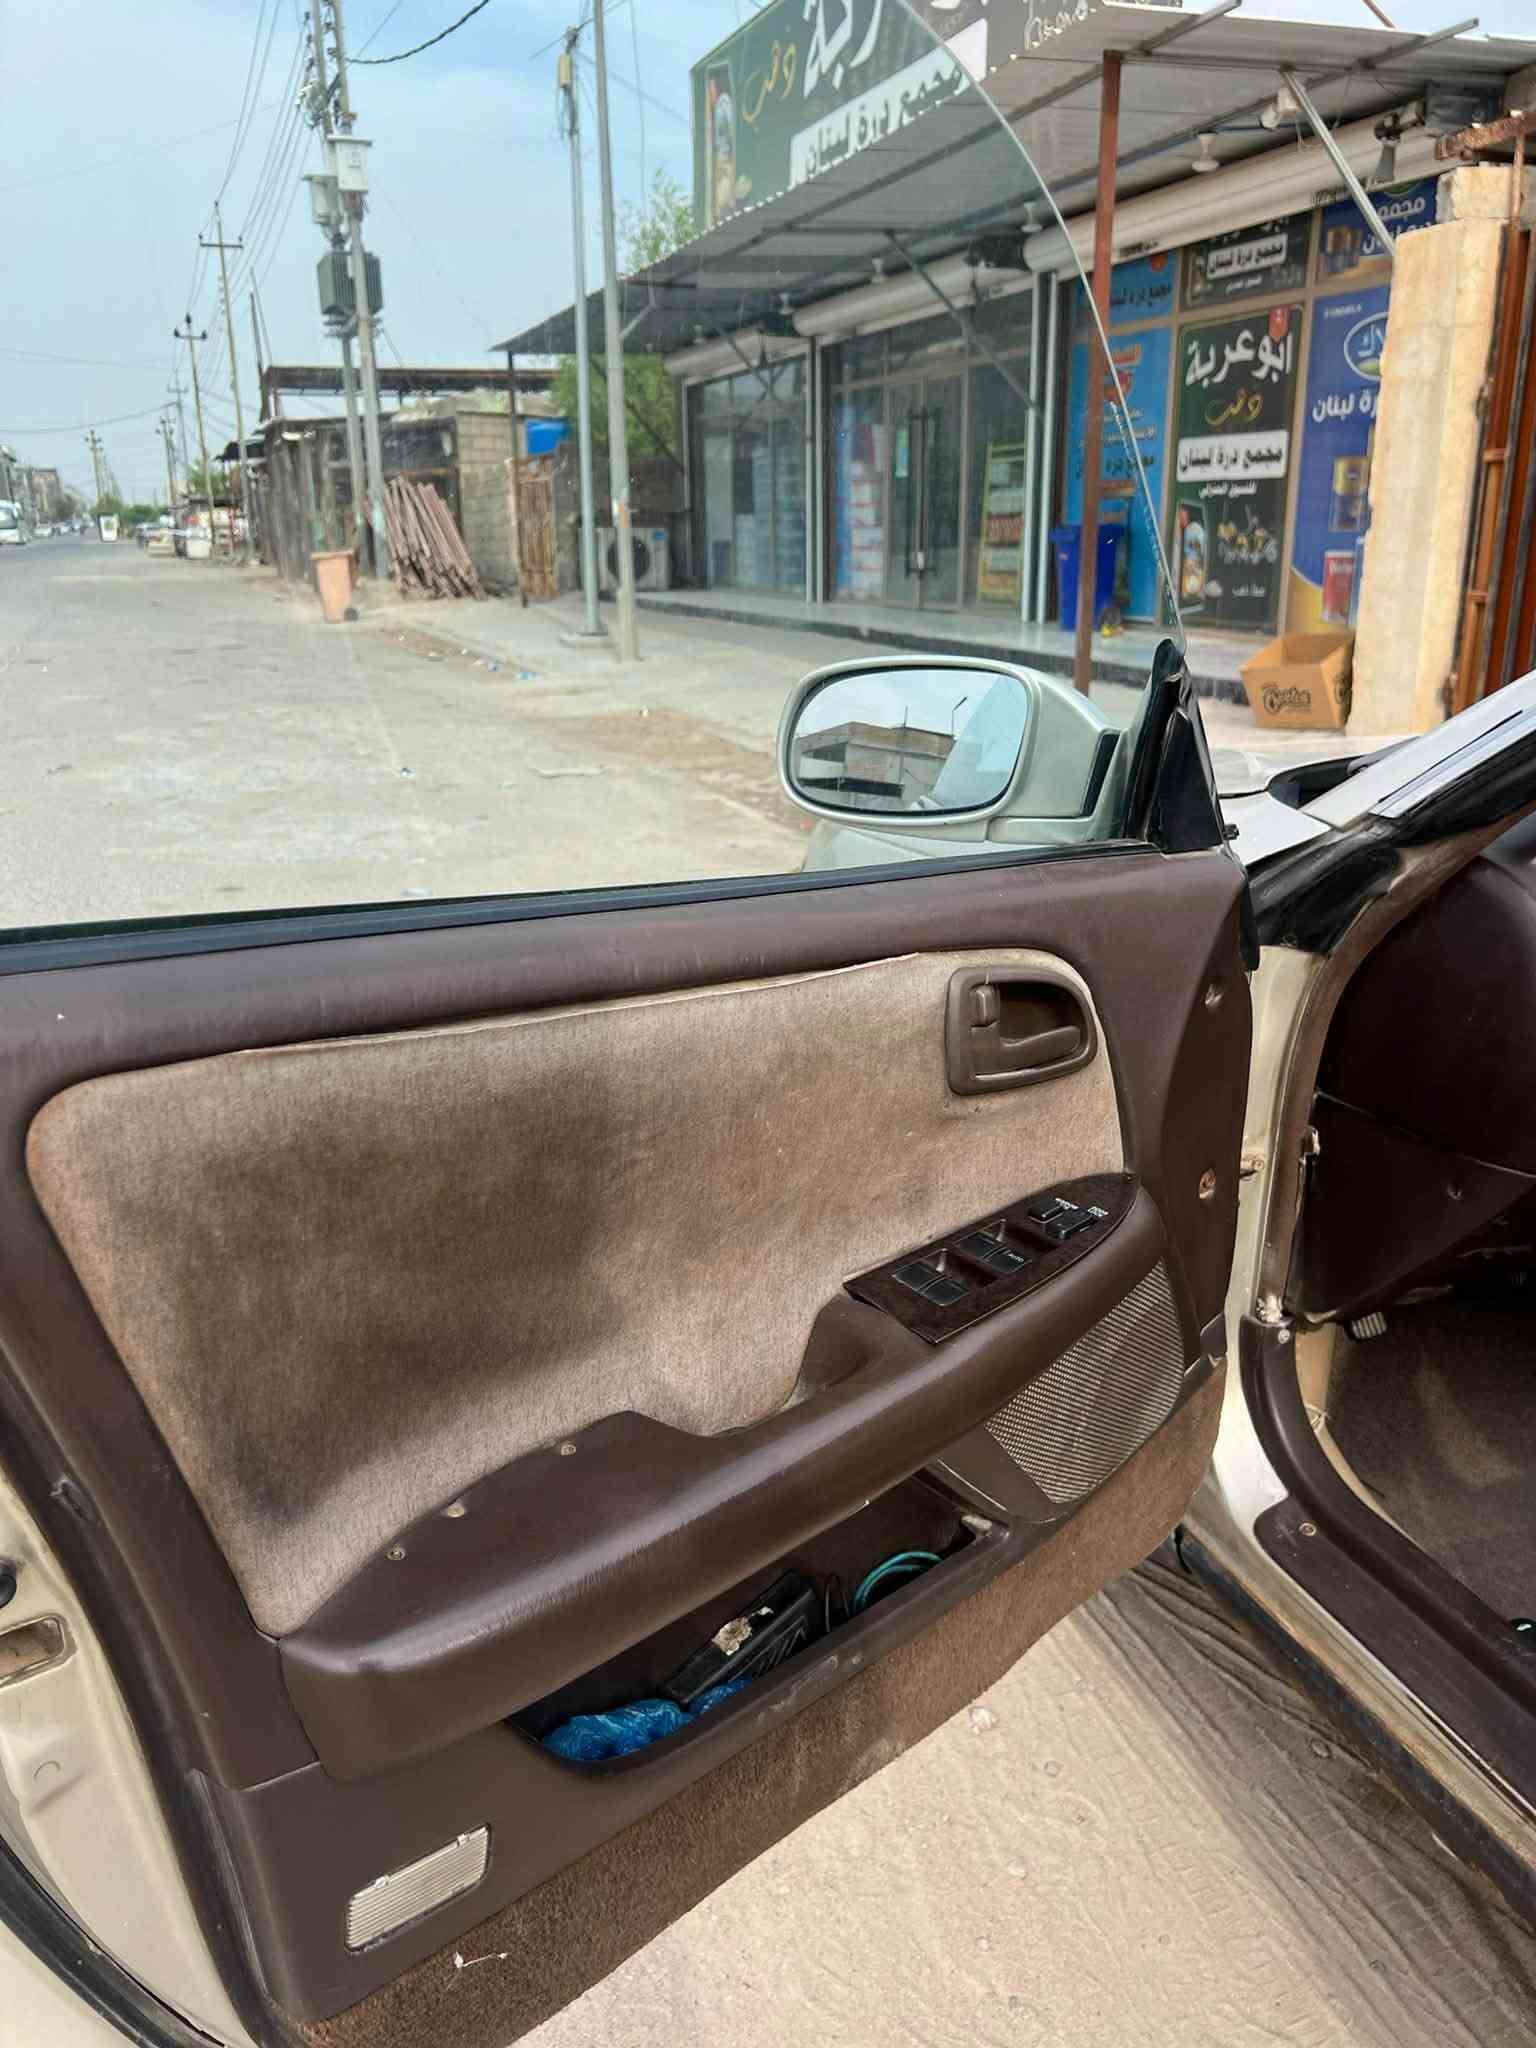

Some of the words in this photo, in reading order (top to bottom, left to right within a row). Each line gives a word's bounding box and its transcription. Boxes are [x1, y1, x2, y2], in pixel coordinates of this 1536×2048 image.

[1312, 392, 1355, 422] لبنان
[1359, 388, 1377, 418] رة
[1179, 446, 1211, 473] لبنان
[1242, 448, 1283, 469] مجمع
